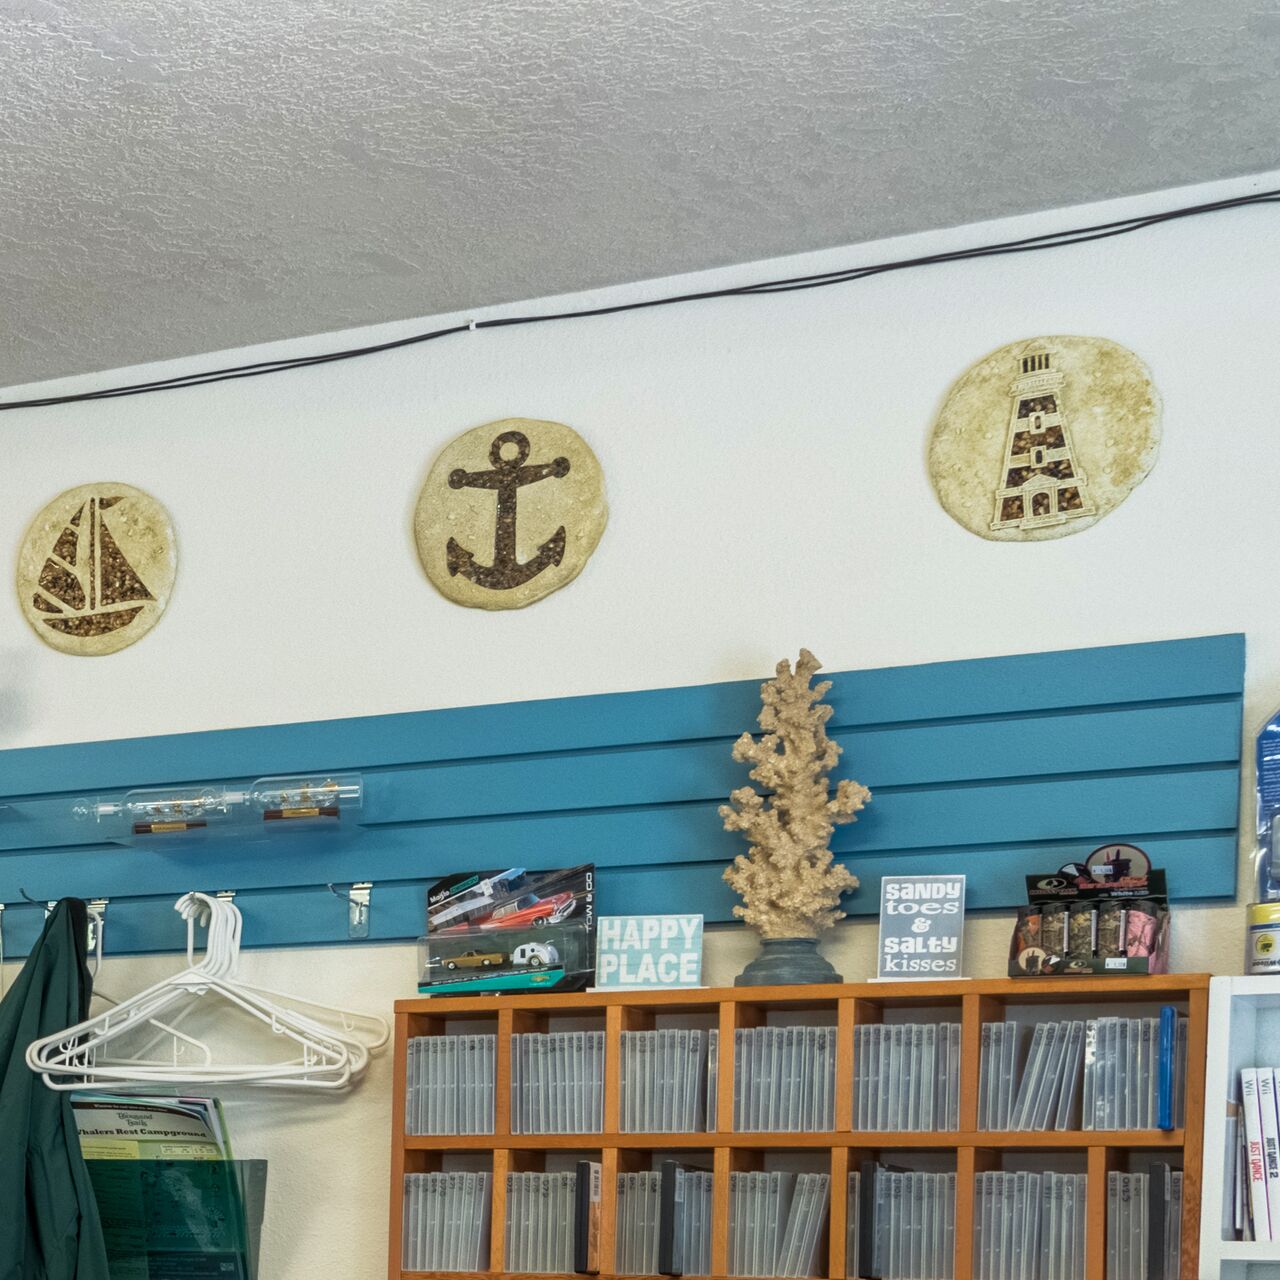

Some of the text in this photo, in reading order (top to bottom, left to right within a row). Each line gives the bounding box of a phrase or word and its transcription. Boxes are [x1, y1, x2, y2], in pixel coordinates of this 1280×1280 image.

[884, 900, 958, 915] toes
[603, 917, 700, 950] HAPPY
[911, 918, 931, 933] &
[600, 953, 697, 983] PLACE
[884, 954, 957, 972] kisses
[1245, 1079, 1254, 1097] Wii
[1260, 1078, 1269, 1096] Wii
[140, 1128, 207, 1138] Campground
[1250, 1141, 1263, 1182] JUST DANCE
[1265, 1136, 1277, 1178] JUST 2
